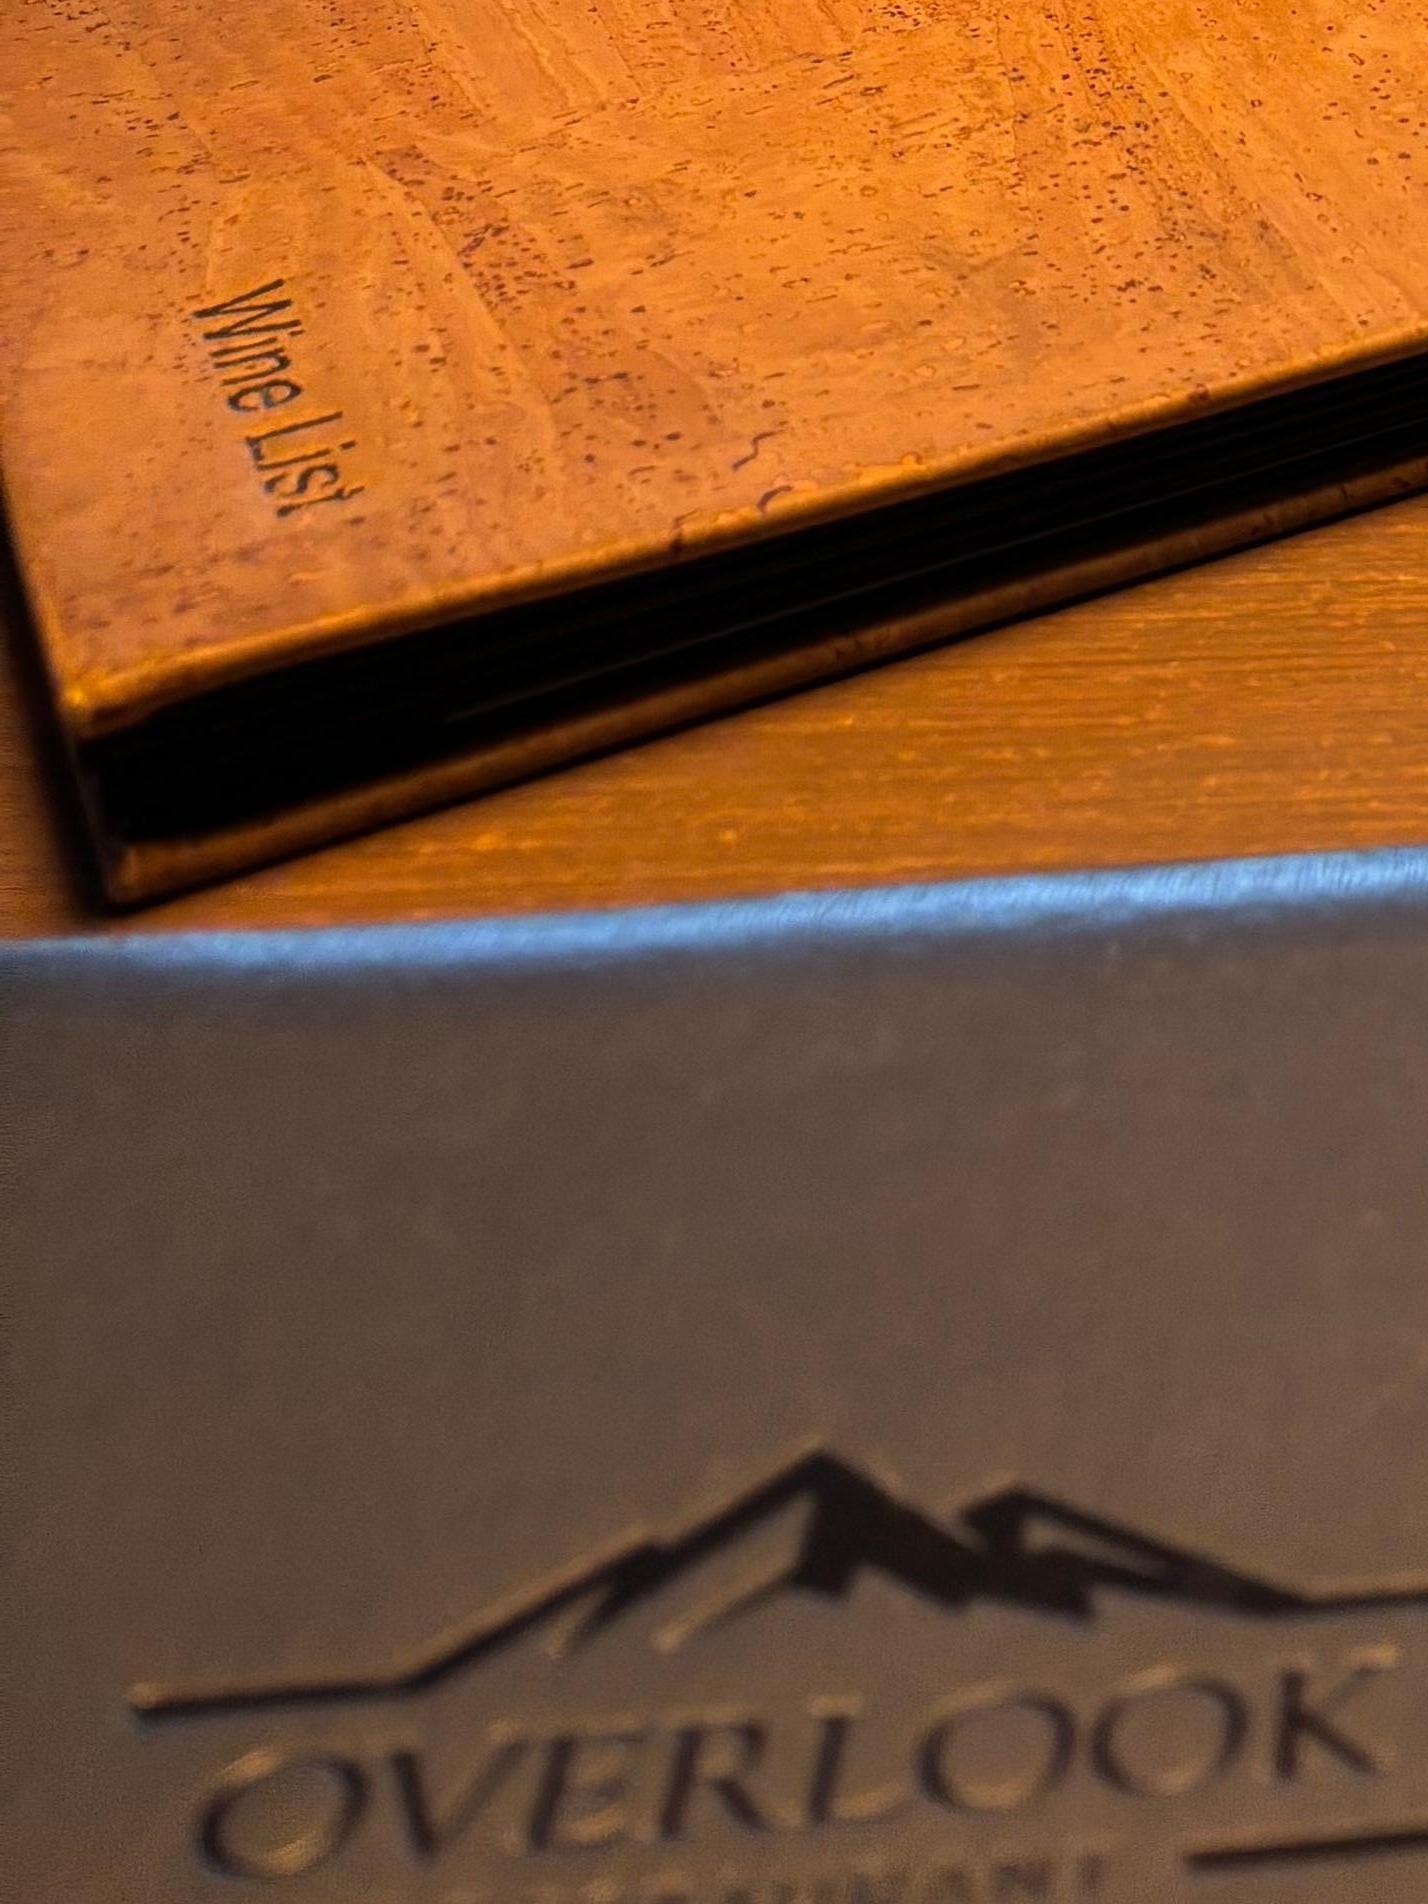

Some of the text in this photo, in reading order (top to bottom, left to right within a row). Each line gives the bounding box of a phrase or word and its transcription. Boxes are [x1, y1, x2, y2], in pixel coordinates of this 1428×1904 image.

[193, 279, 365, 516] Wine List
[197, 1645, 1401, 1880] OVERLOOK
